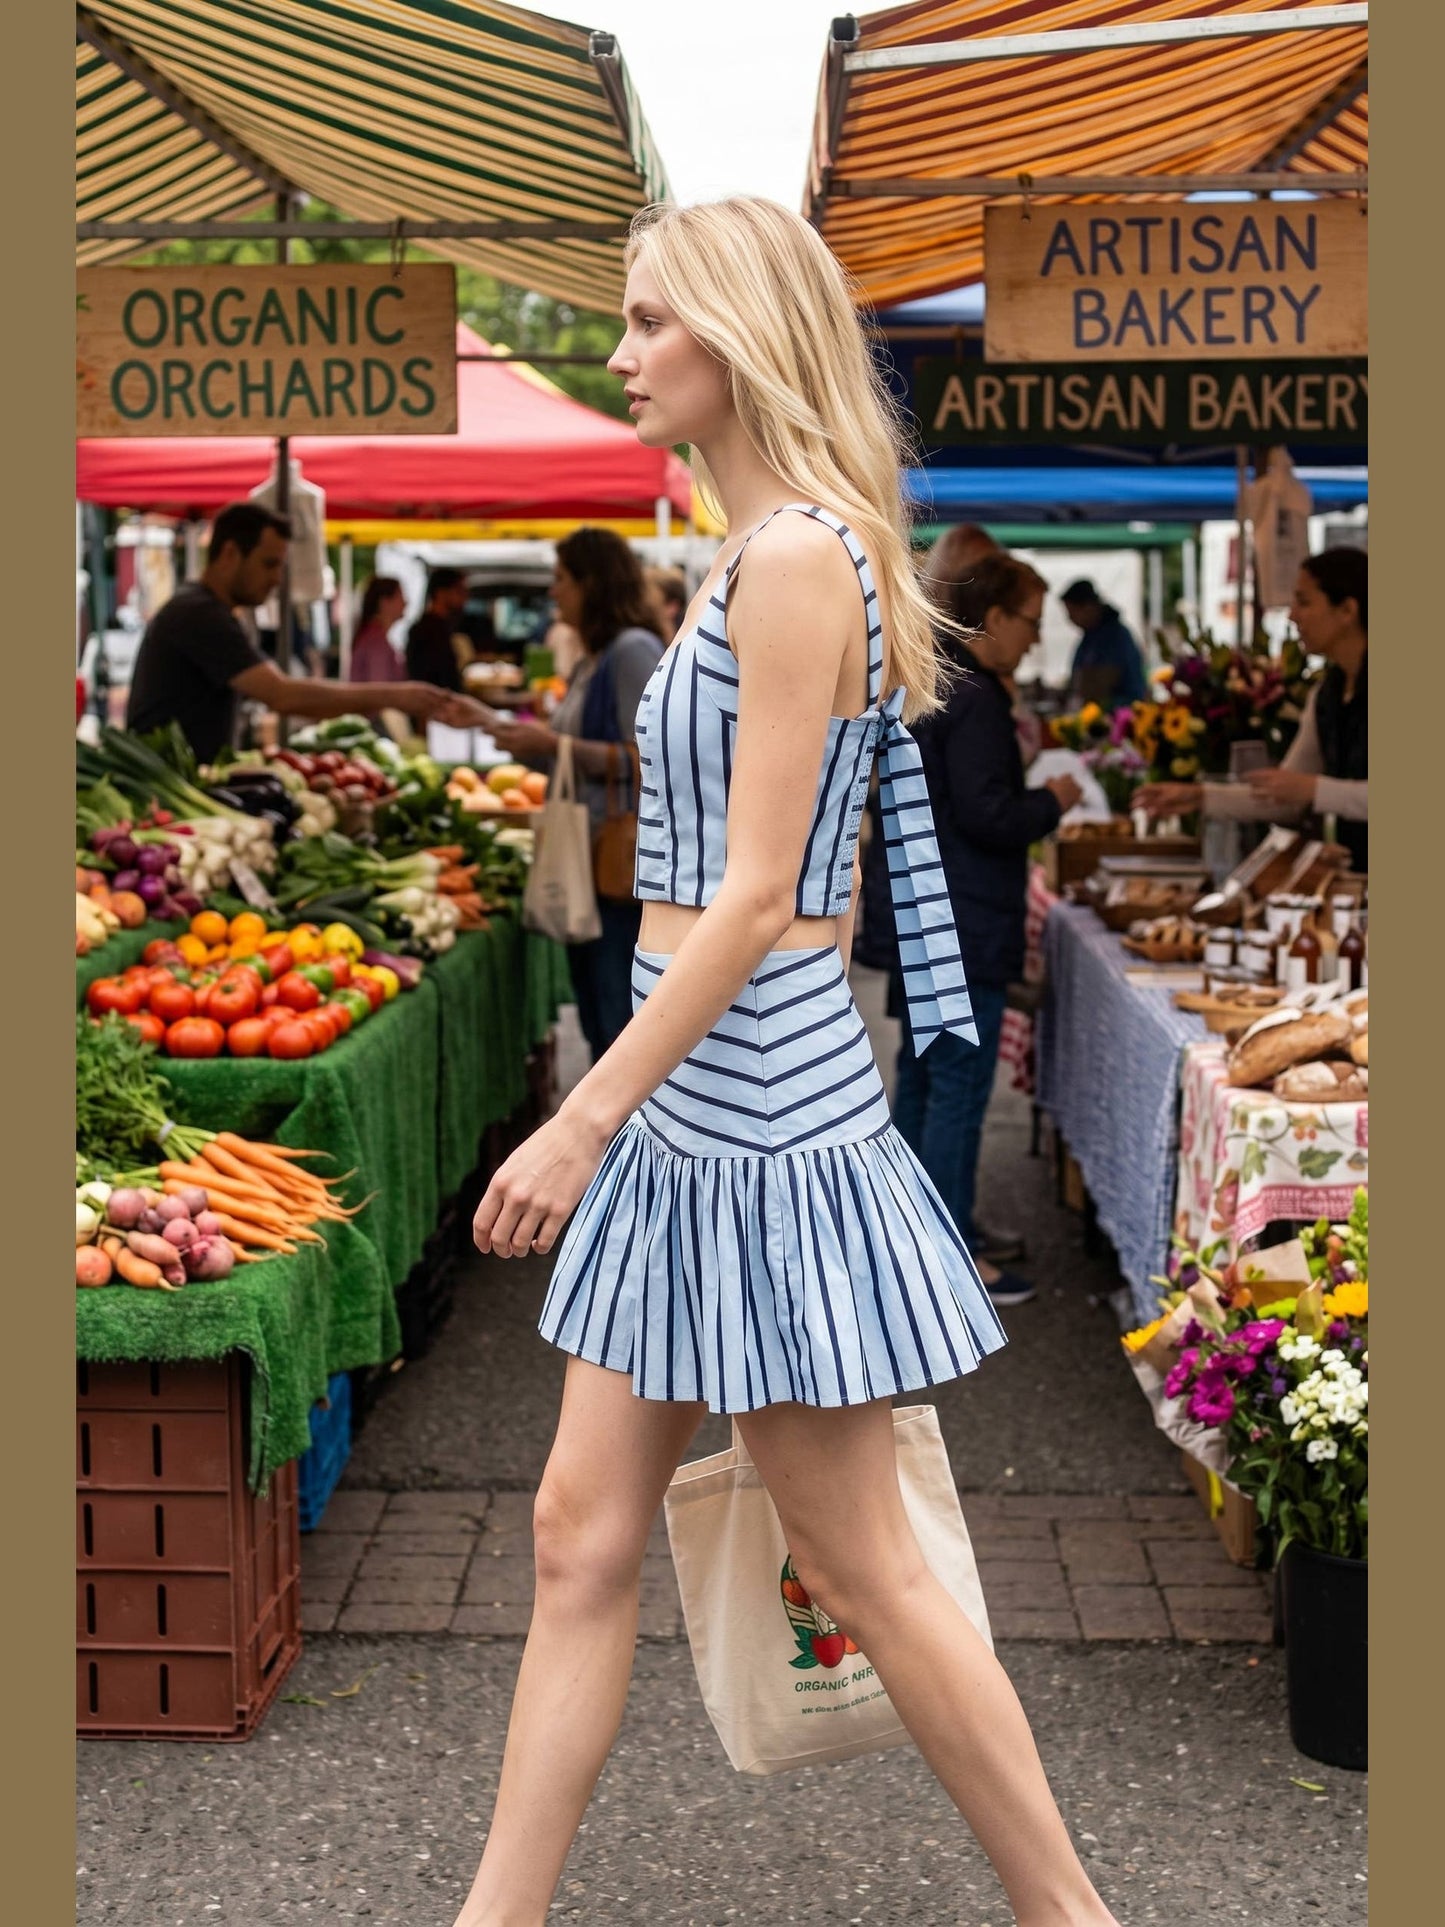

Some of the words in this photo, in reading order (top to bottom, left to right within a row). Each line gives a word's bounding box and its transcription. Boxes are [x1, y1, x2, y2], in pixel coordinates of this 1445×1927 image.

[1040, 213, 1317, 277] ARTISAN
[122, 285, 405, 348] ORGANIC
[1073, 284, 1322, 349] BAKERY
[110, 357, 436, 420] ORCHARDS
[933, 373, 1165, 431] ARTISAN
[794, 1676, 849, 1692] ORGANIC
